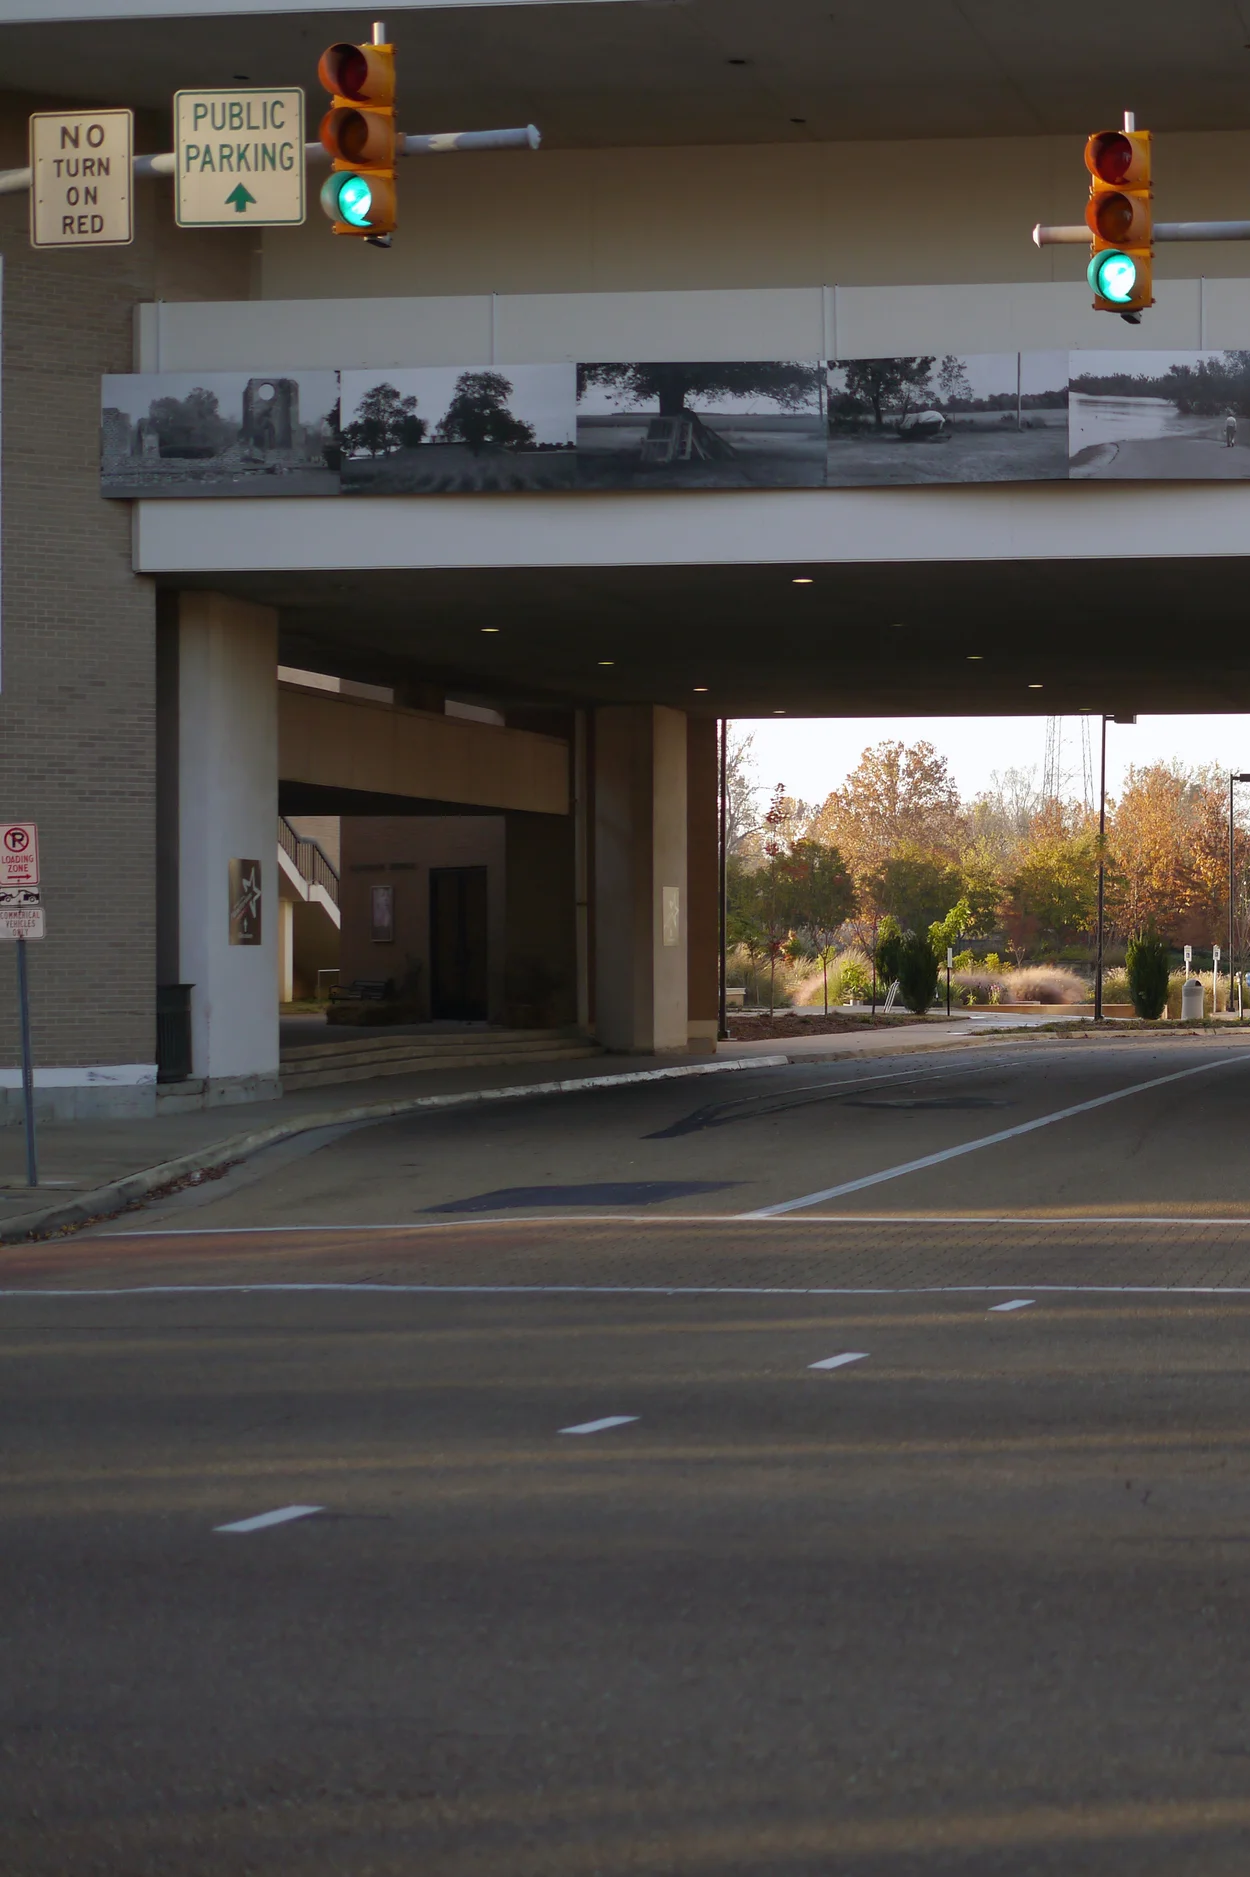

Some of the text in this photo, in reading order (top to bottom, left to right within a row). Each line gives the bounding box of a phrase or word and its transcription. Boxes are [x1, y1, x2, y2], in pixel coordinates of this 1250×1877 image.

[193, 100, 285, 131] PUBLIC
[60, 124, 105, 149] NO
[53, 157, 110, 177] TURN
[185, 142, 294, 173] PARKING
[66, 186, 98, 206] ON
[62, 215, 104, 235] RED
[1, 855, 34, 864] LOADING
[7, 864, 29, 872] ZONE
[5, 919, 36, 928] VEHICLES
[12, 928, 29, 936] ONLY
